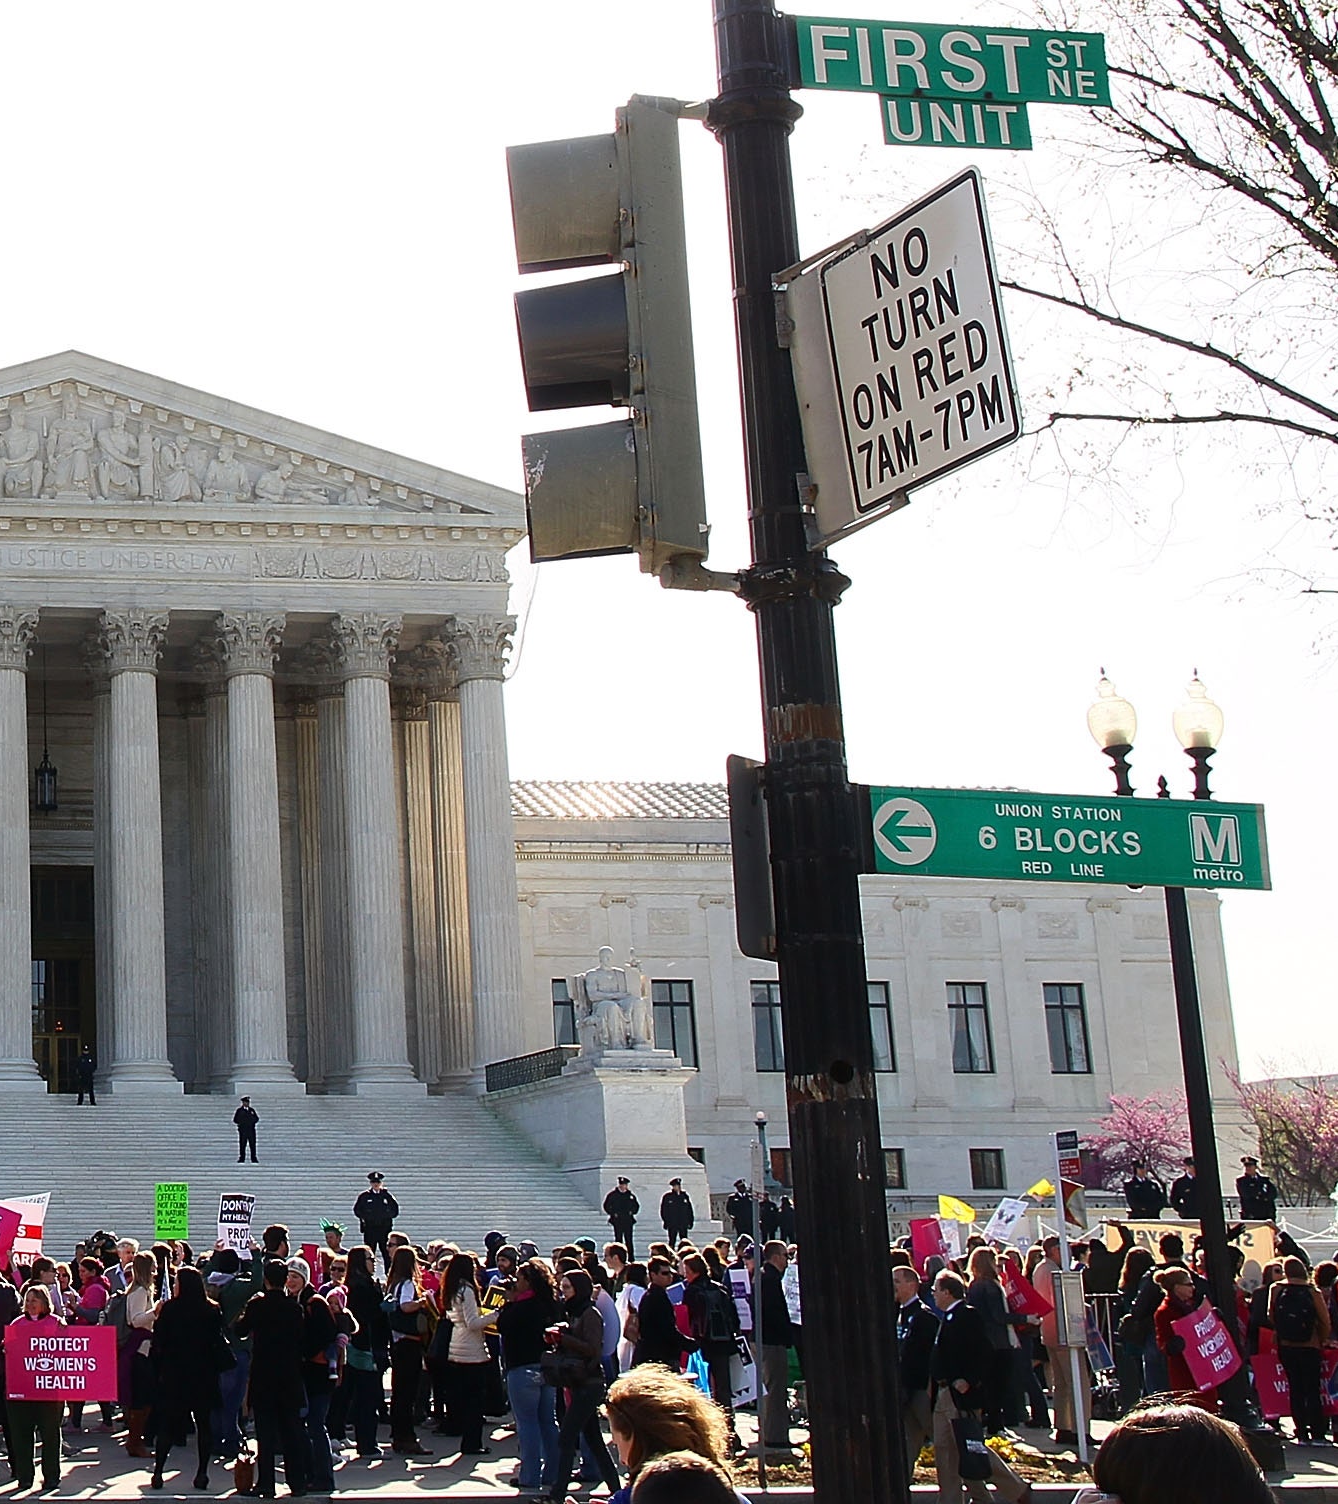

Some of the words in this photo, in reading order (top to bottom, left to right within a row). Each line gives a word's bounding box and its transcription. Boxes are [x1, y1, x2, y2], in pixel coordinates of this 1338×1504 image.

[810, 25, 1030, 94] FIRST
[1045, 38, 1087, 68] ST
[1047, 69, 1098, 99] NE
[888, 100, 1017, 144] UNIT
[870, 226, 928, 300] NO
[862, 268, 960, 363] TURN
[853, 365, 903, 431] ON
[912, 319, 988, 401] RED
[857, 374, 1006, 490] 7AM-7PM
[100, 551, 180, 570] UNDER
[190, 553, 237, 571] LAW
[995, 803, 1043, 818] UNION
[1051, 806, 1121, 822] STATION
[978, 826, 998, 850] 6
[1014, 827, 1141, 856] BLOCKS
[1191, 815, 1239, 864] M
[1022, 861, 1052, 875] RED
[1071, 863, 1104, 877] LINE
[1193, 866, 1244, 882] metro
[228, 1227, 250, 1239] PROT
[239, 1239, 250, 1250] LA
[30, 1338, 90, 1352] PROTECT
[35, 1375, 86, 1390] HEALTH
